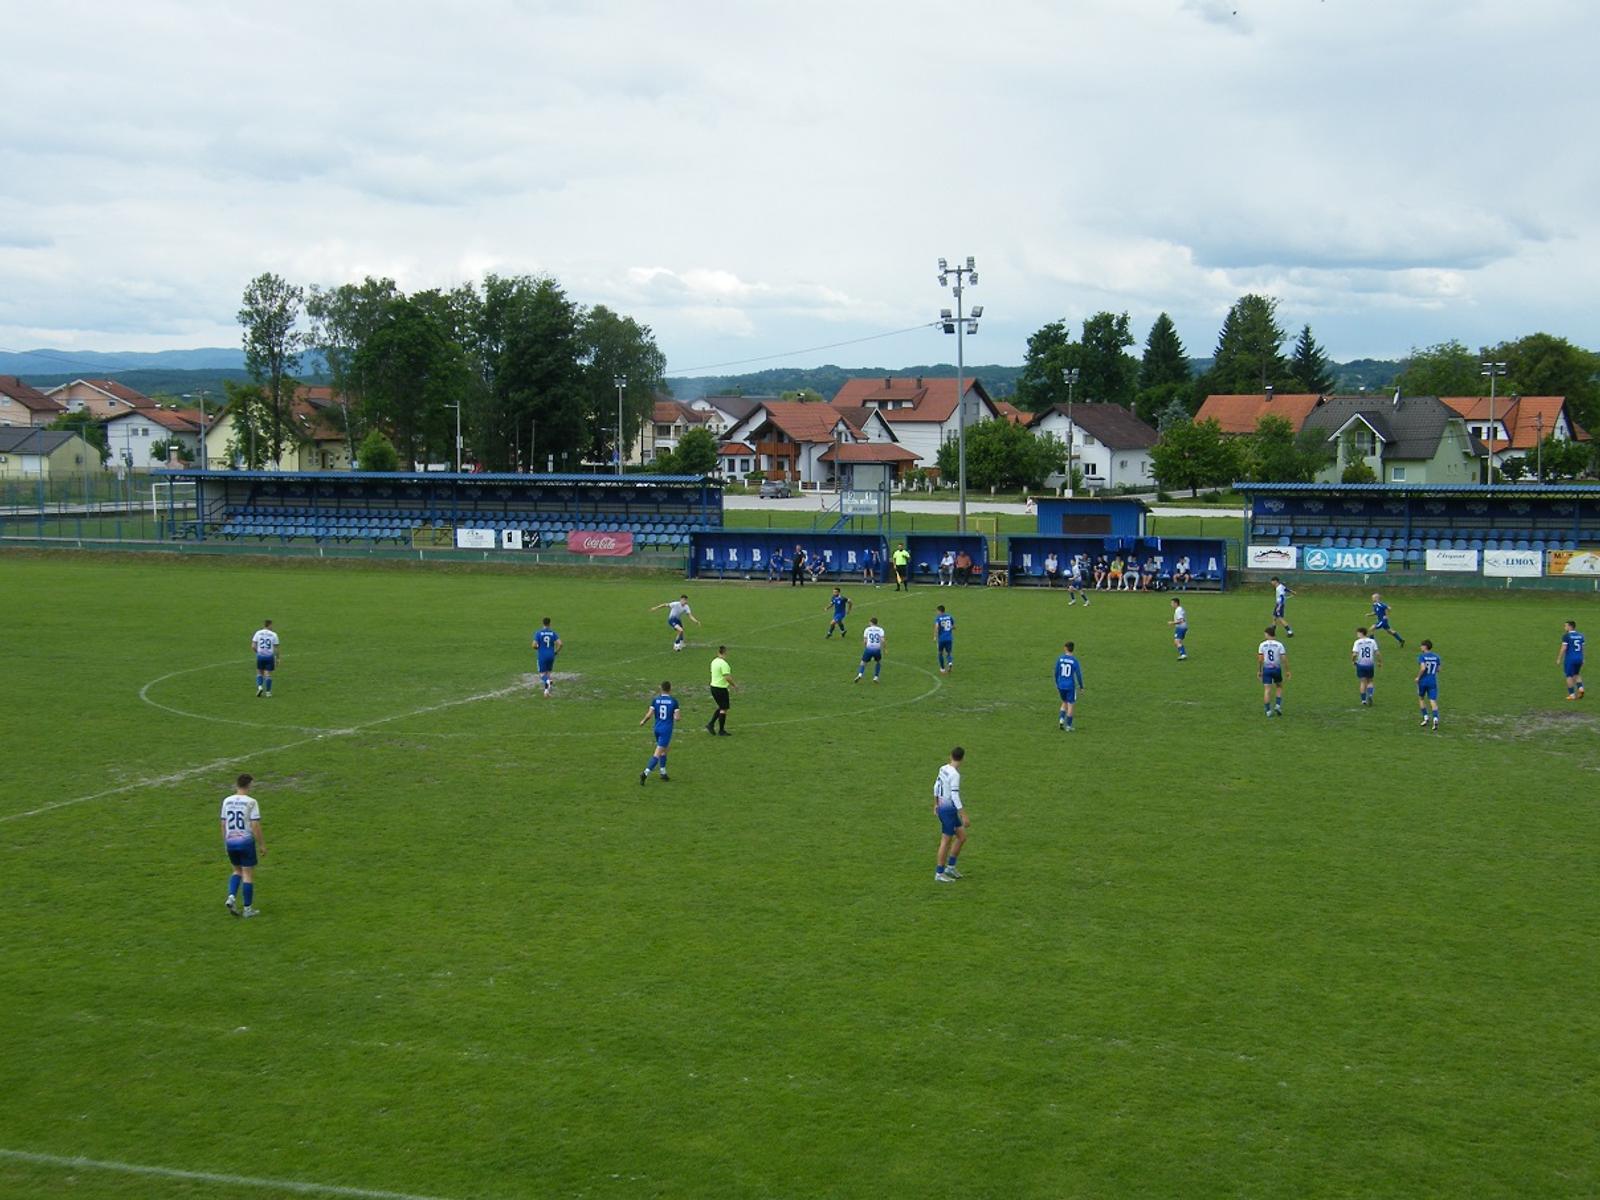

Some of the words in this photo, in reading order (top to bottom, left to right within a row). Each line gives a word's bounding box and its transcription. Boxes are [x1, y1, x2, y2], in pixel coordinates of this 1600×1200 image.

[1333, 553, 1384, 569] JAKO
[260, 639, 272, 650] 29
[543, 636, 550, 648] 9
[1573, 640, 1581, 652] 5
[1267, 649, 1275, 661] 8
[1361, 647, 1371, 658] 18
[1060, 663, 1072, 678] 10
[659, 704, 668, 720] 8
[227, 810, 245, 830] 26
